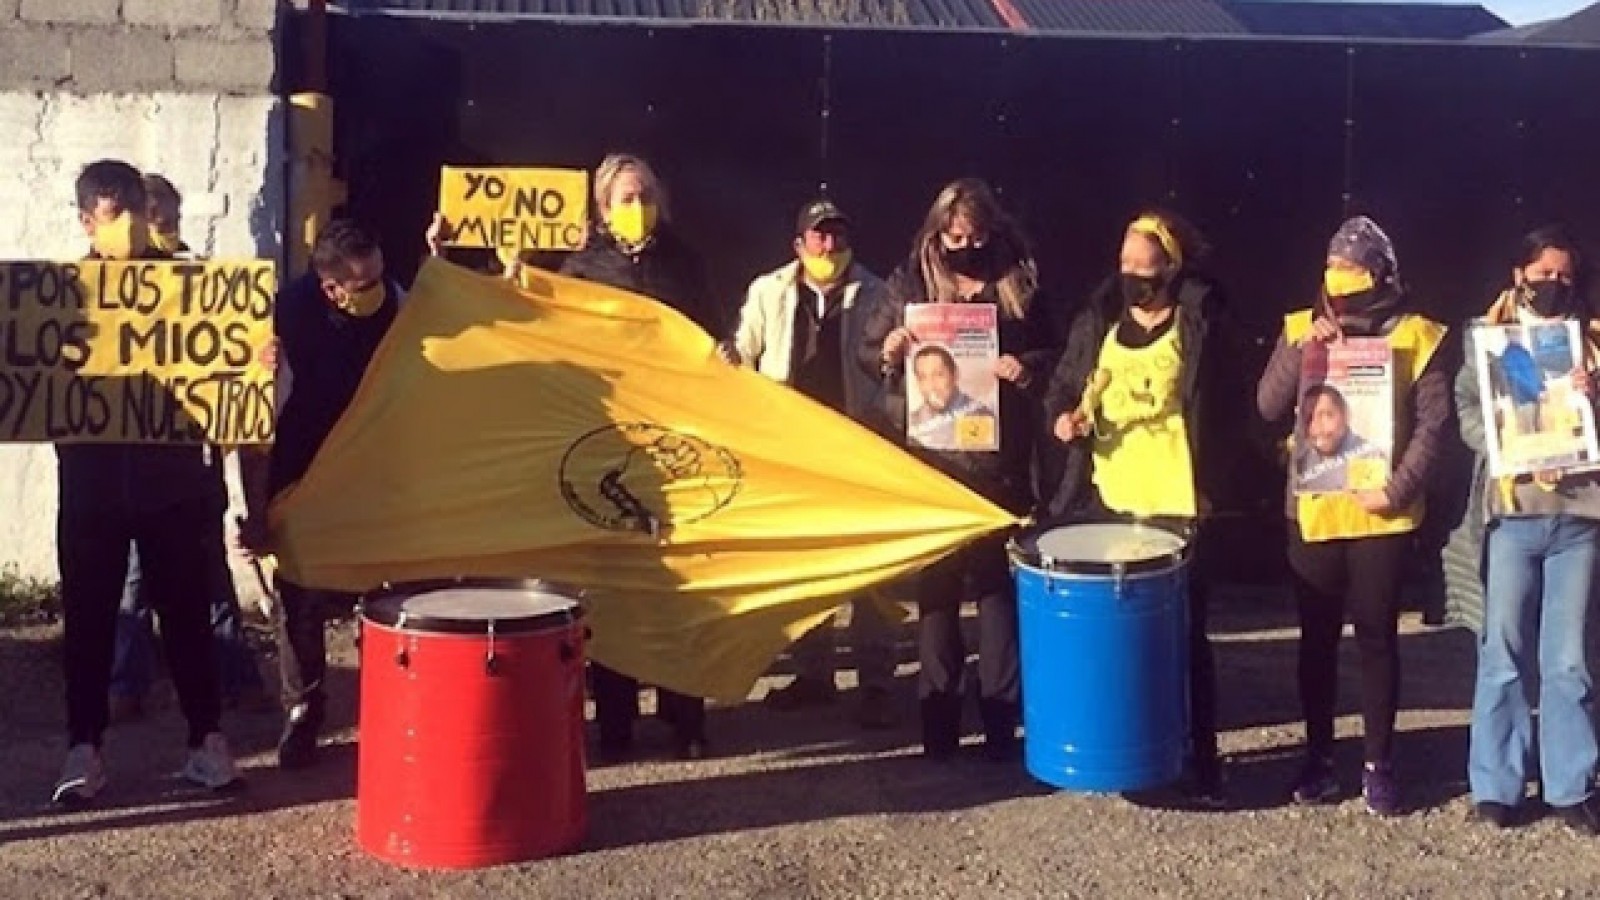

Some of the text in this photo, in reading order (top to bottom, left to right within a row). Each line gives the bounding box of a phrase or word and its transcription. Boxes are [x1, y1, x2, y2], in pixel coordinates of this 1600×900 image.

[463, 172, 565, 219] YO NO
[9, 262, 272, 321] POR LOS TUYOS
[7, 318, 249, 370] LOS MIOS
[46, 375, 110, 437] LOS
[122, 368, 274, 443] NUESTROS
